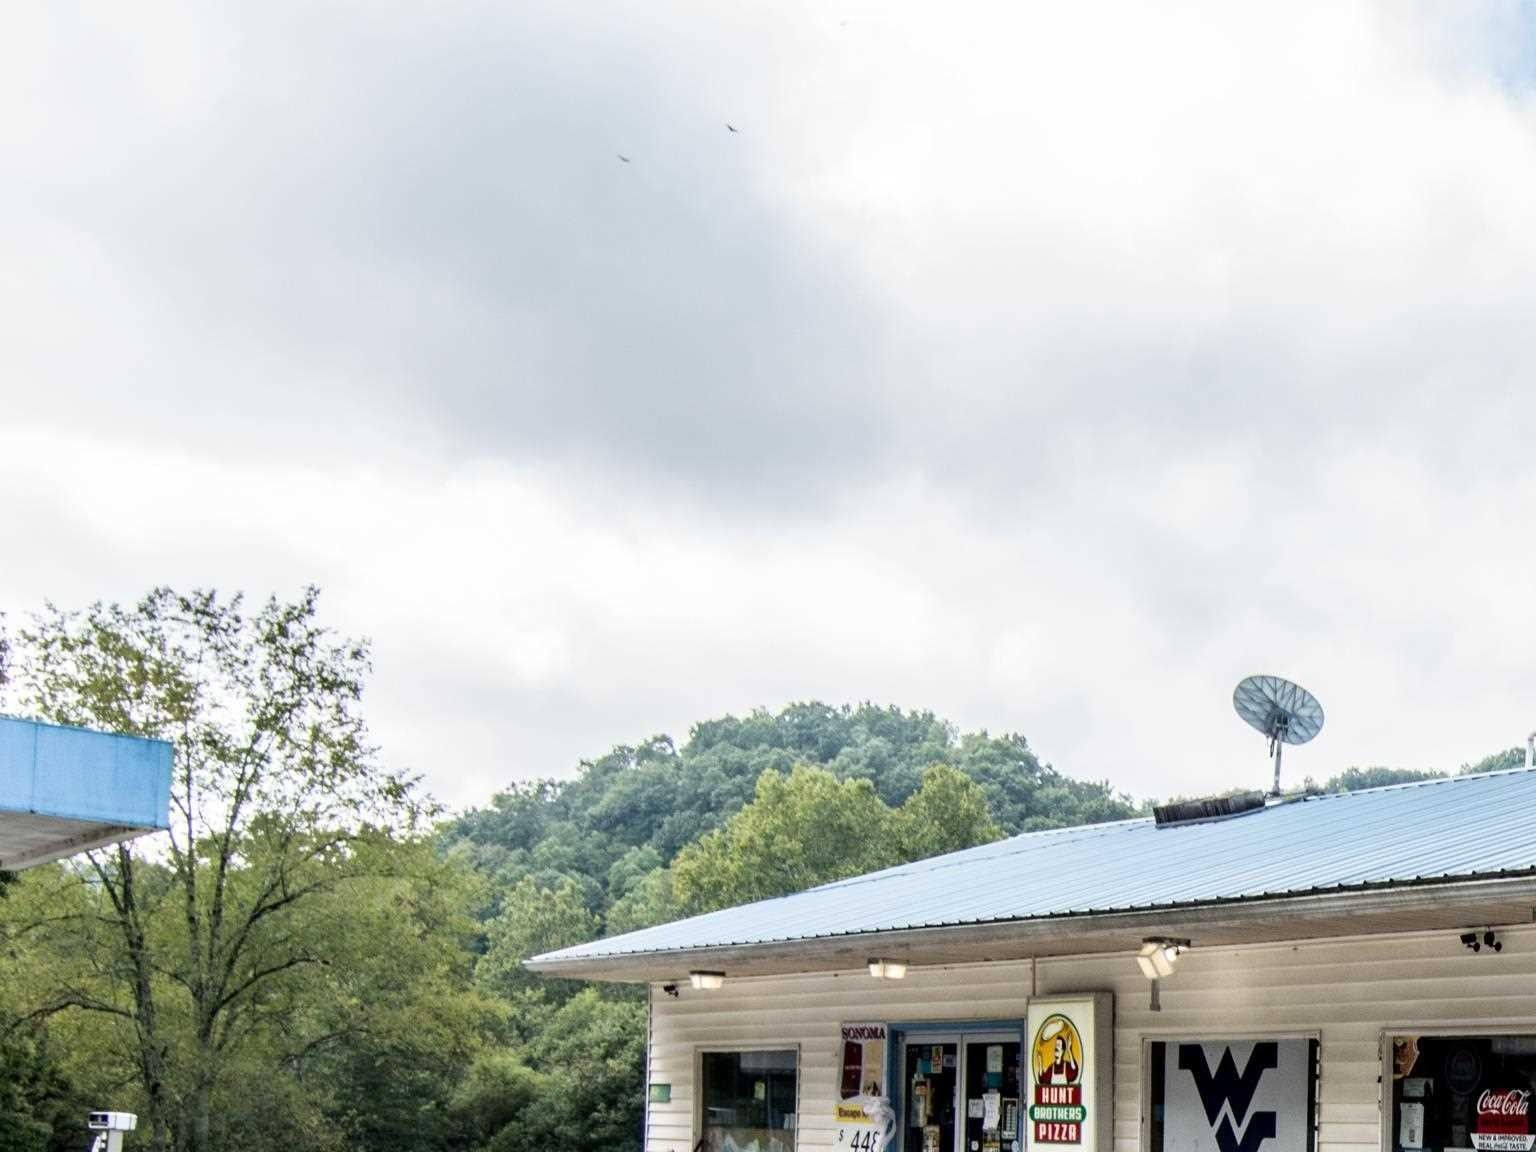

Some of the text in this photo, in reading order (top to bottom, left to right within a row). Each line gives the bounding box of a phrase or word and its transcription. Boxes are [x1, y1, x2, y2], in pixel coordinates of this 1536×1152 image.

[841, 1027, 886, 1040] SONOMA
[1041, 1087, 1075, 1104] HUNT
[1476, 1089, 1531, 1115] Coca-Cola
[1034, 1106, 1082, 1120] BROTHERS
[1039, 1123, 1077, 1141] PIZZA
